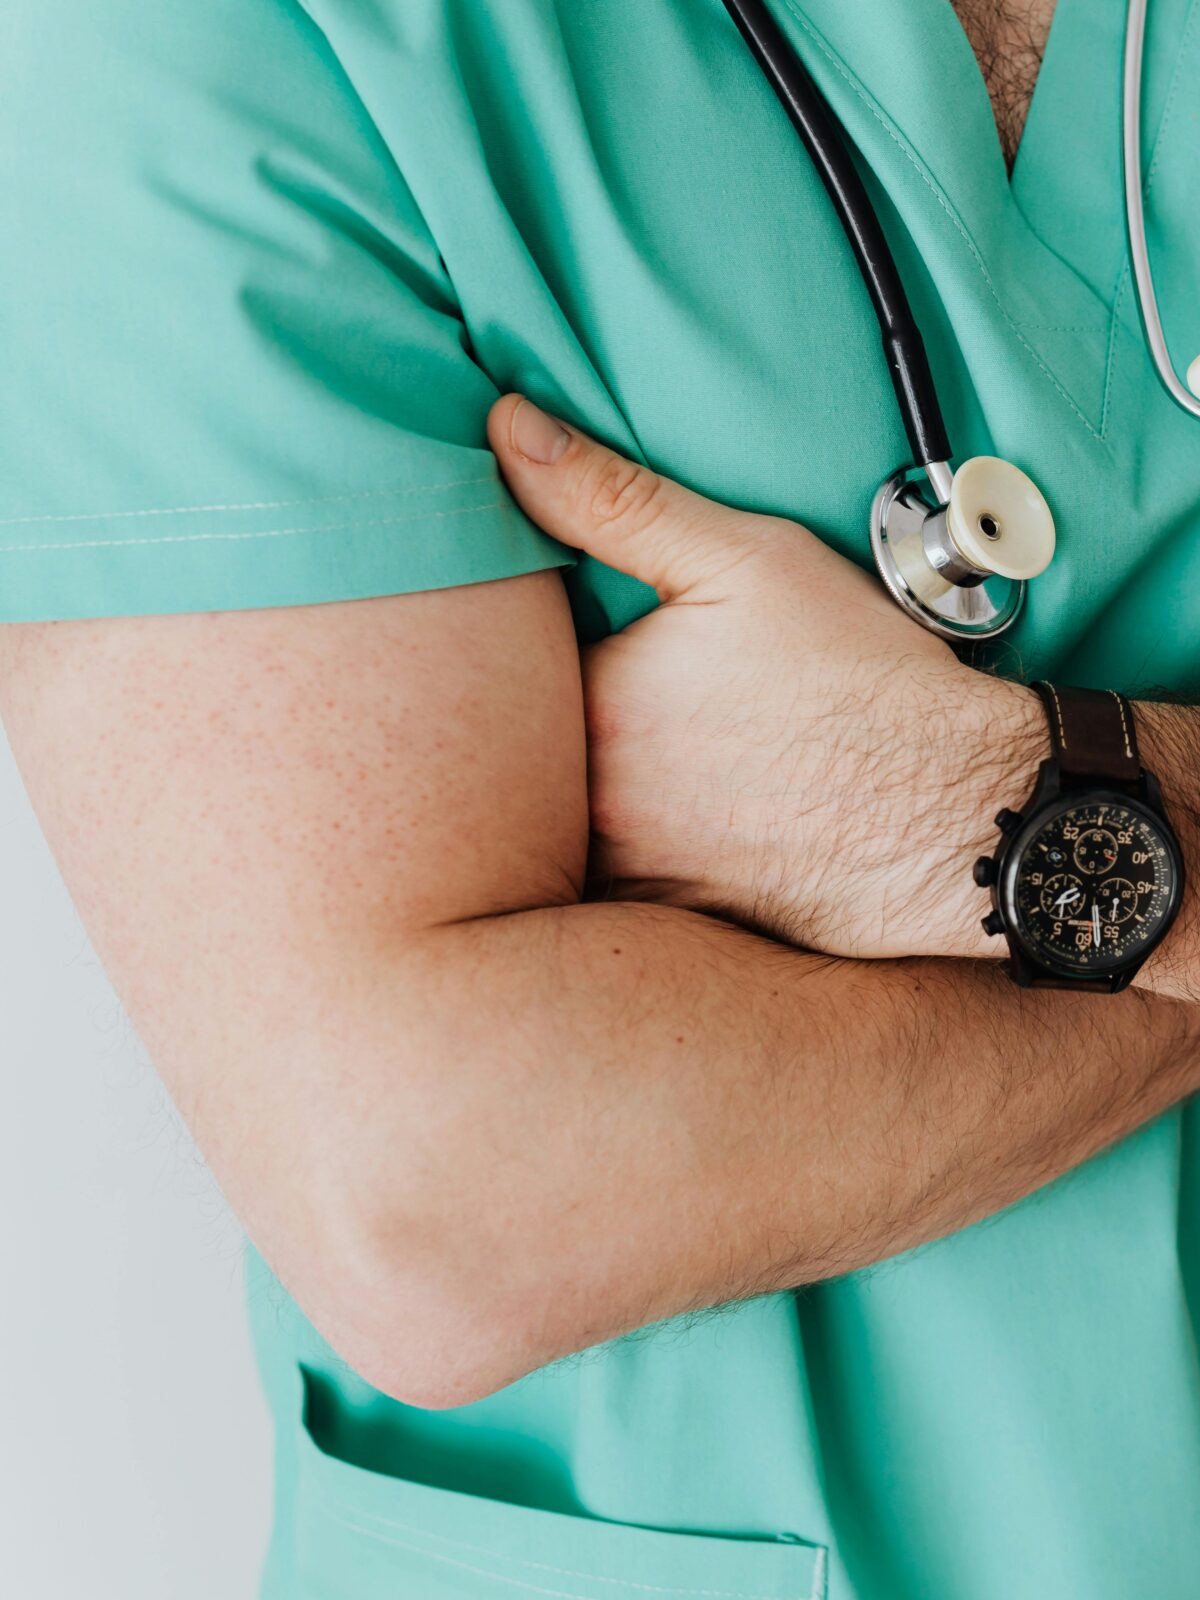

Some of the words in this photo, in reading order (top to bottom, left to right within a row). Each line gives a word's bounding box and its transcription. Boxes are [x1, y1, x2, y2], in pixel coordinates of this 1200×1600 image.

[1063, 827, 1080, 840] 25
[1118, 831, 1134, 844] 35
[1088, 860, 1096, 868] 0
[1132, 851, 1148, 864] 40
[1031, 873, 1043, 886] 15
[1102, 888, 1110, 896] 10
[1122, 890, 1132, 898] 20
[1136, 881, 1152, 894] 45
[1052, 922, 1062, 935] 5
[1104, 926, 1120, 938] 55
[1076, 932, 1092, 945] 60
